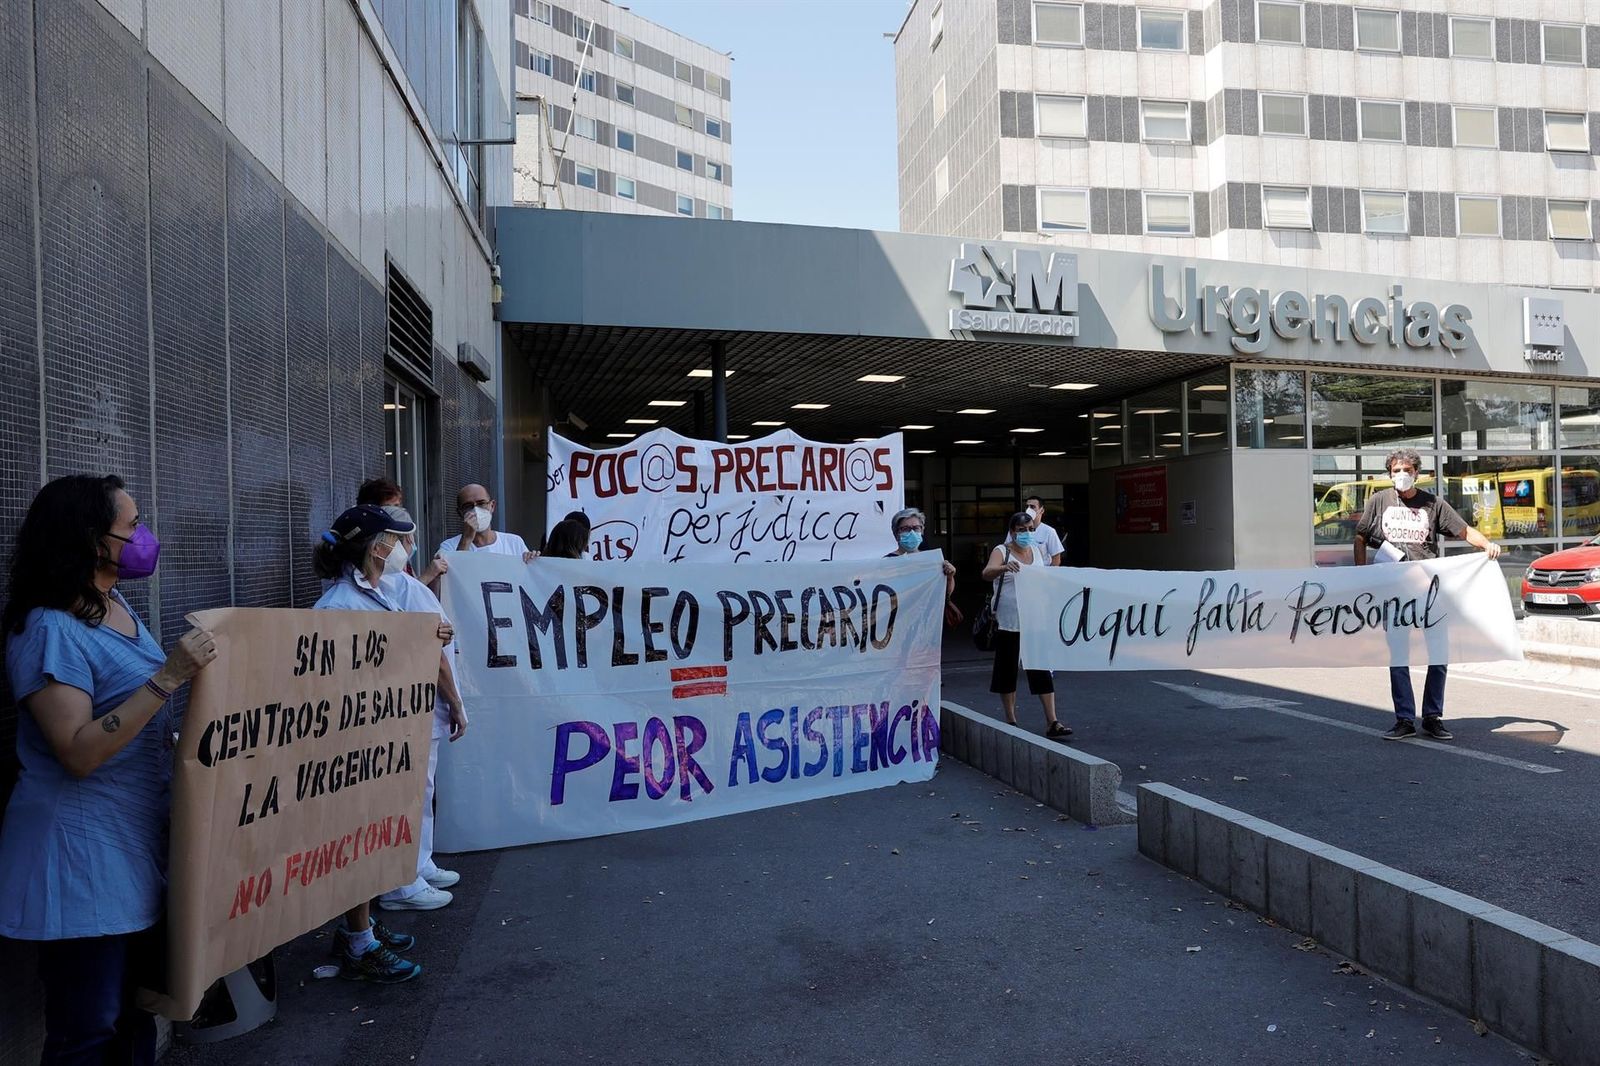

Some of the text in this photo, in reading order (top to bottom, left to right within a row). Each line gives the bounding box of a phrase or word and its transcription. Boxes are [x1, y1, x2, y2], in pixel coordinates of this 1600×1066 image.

[1147, 262, 1475, 355] Urgencias
[1524, 349, 1564, 361] Madrid
[569, 443, 697, 499] POC@S
[712, 445, 894, 494] PRECARI@S
[664, 495, 860, 556] perjudica
[1387, 527, 1425, 541] PODEMOS
[1390, 509, 1422, 522] JUNTOS
[586, 535, 633, 562] ats
[480, 579, 898, 670] EMPLEO PRECARIO
[1058, 574, 1447, 666] Aquí falta Personal
[293, 629, 388, 677] SIN LOS
[197, 698, 330, 768] CENTROS
[549, 700, 940, 806] PEOR ASISTENCIA
[238, 741, 411, 827] LA URGENCIA
[229, 814, 412, 920] NO FUNCIONA
